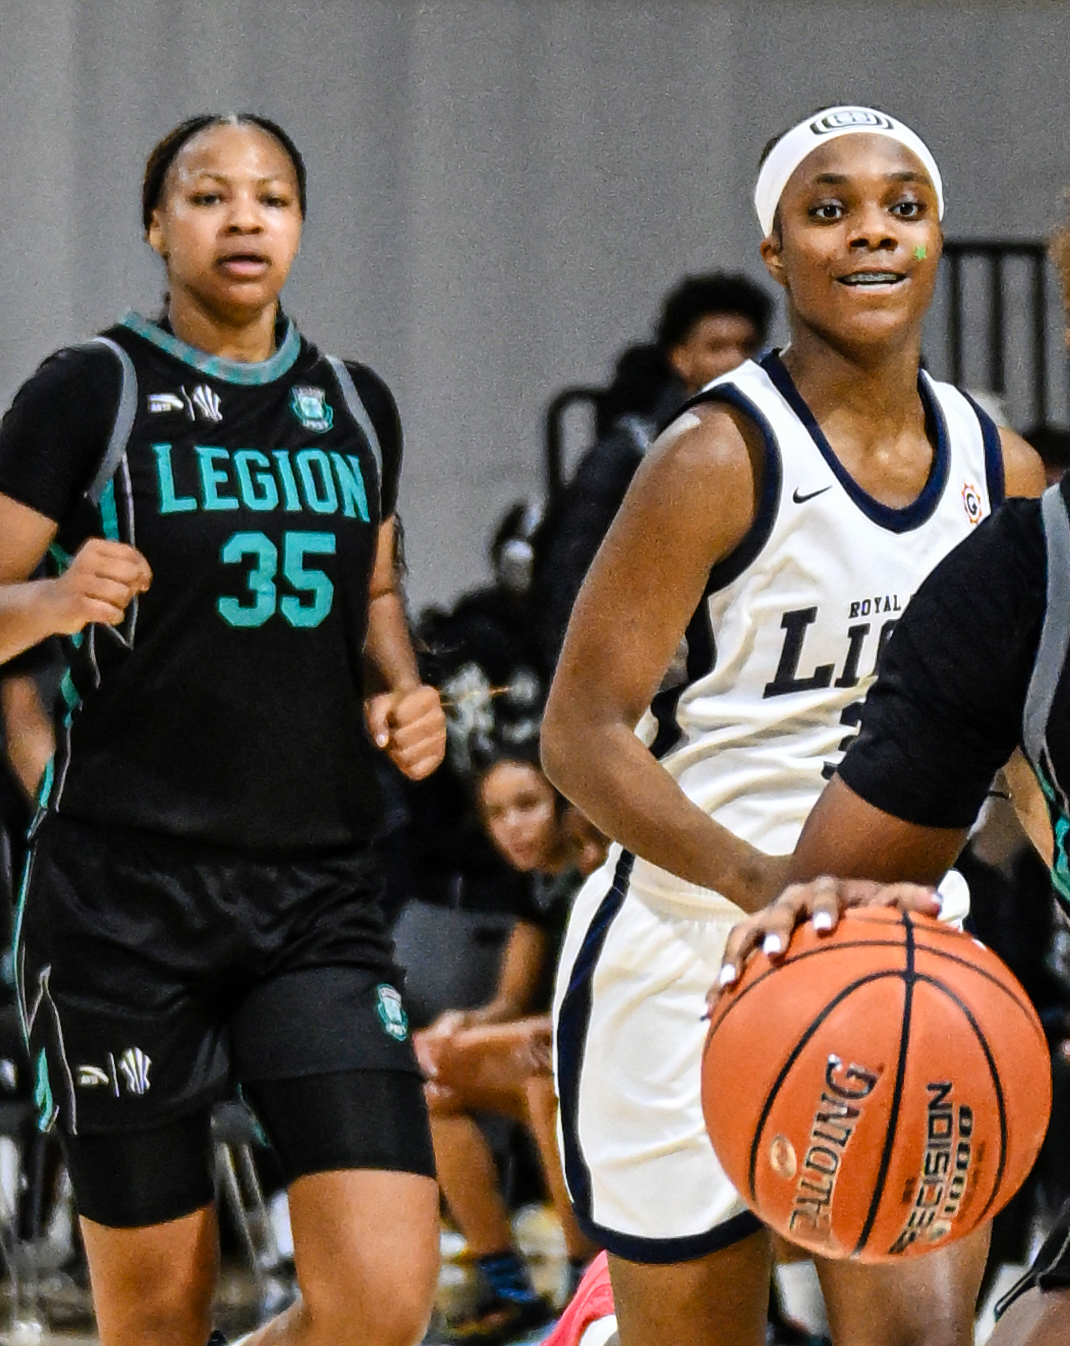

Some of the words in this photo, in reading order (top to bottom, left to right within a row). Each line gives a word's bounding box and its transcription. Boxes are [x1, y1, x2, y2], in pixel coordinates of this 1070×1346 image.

[151, 443, 370, 523] LEGION
[216, 531, 337, 628] 35
[849, 594, 902, 619] ROYAL
[762, 606, 899, 699] LI
